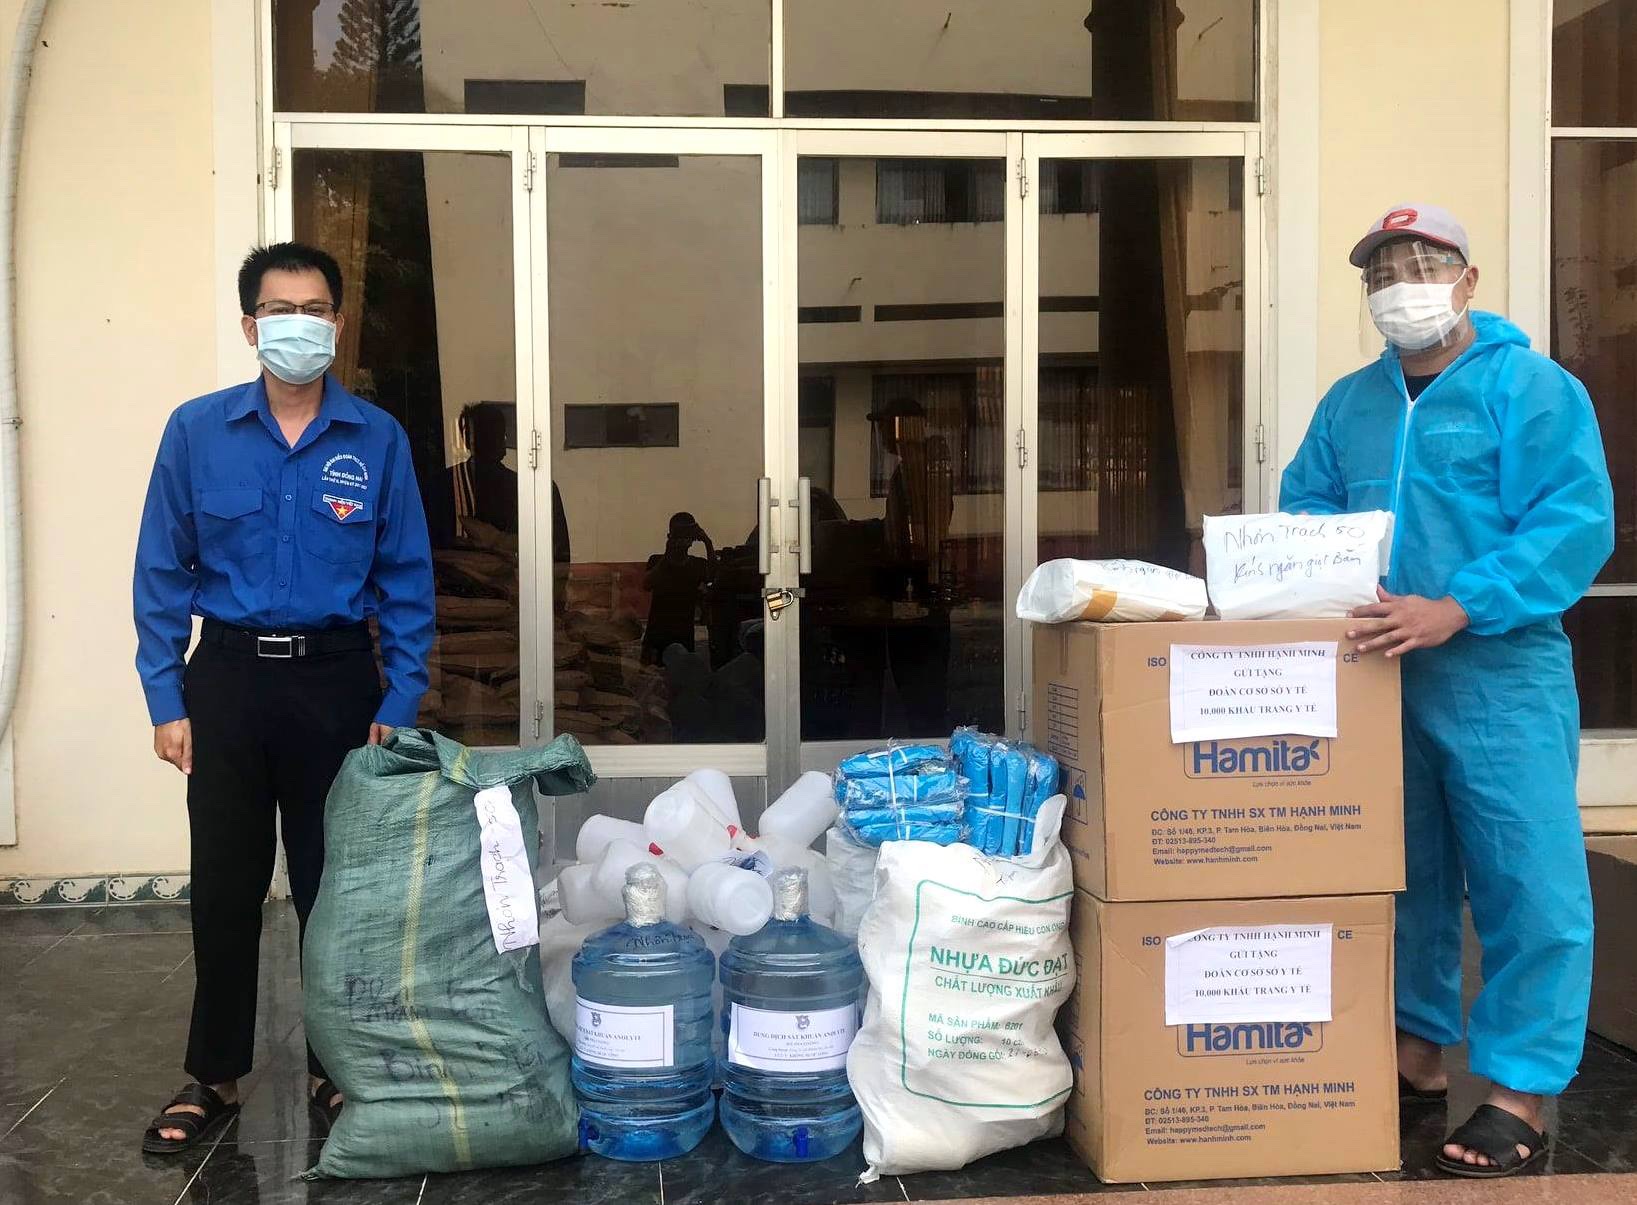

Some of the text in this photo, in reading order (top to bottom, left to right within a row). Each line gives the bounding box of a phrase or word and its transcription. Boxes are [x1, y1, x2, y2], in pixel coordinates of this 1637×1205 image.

[341, 472, 355, 481] ĐỒNG
[1336, 525, 1365, 538] 50
[1190, 649, 1326, 660] CÔNG TY TNHH HẠNH MINH
[1147, 653, 1360, 668] ISO CE
[1285, 686, 1293, 694] Y
[1259, 704, 1293, 714] TRANG
[1295, 704, 1302, 713] Y
[1193, 739, 1312, 775] Hamita
[1150, 804, 1362, 822] CÔNG TY TNHH SX TM HẠNH MINH
[1345, 822, 1362, 831] Nam
[1152, 847, 1175, 855] Email:
[1153, 855, 1258, 866] Website: www.hanhminh.com
[976, 919, 997, 929] CAO
[1142, 929, 1354, 947] ISO CE
[1219, 933, 1231, 941] TY
[1234, 931, 1261, 941] TNHH
[1263, 931, 1292, 942] HẠNH
[1294, 930, 1321, 939] MINH
[930, 944, 1069, 977] NHỰA ĐỨC ĐẠT
[1280, 967, 1288, 976] Y
[934, 974, 968, 992] CHẤT
[970, 980, 1013, 997] LƯỢNG
[1014, 982, 1043, 999] XUẤT
[1254, 985, 1288, 996] TRANG
[1289, 986, 1297, 994] Y
[927, 1027, 943, 1042] SỐ
[945, 1033, 983, 1047] LƯỢNG:
[1186, 1021, 1305, 1052] Hamita
[927, 1047, 957, 1059] NGÀY
[958, 1049, 987, 1060] ĐÓNG
[1144, 1081, 1355, 1101] CÔNG TY TNHH SX TM HẠNH MINH
[1339, 1100, 1356, 1108] Nam
[1145, 1127, 1168, 1135] Email:
[1180, 1135, 1252, 1144] www.hanhminh.com
